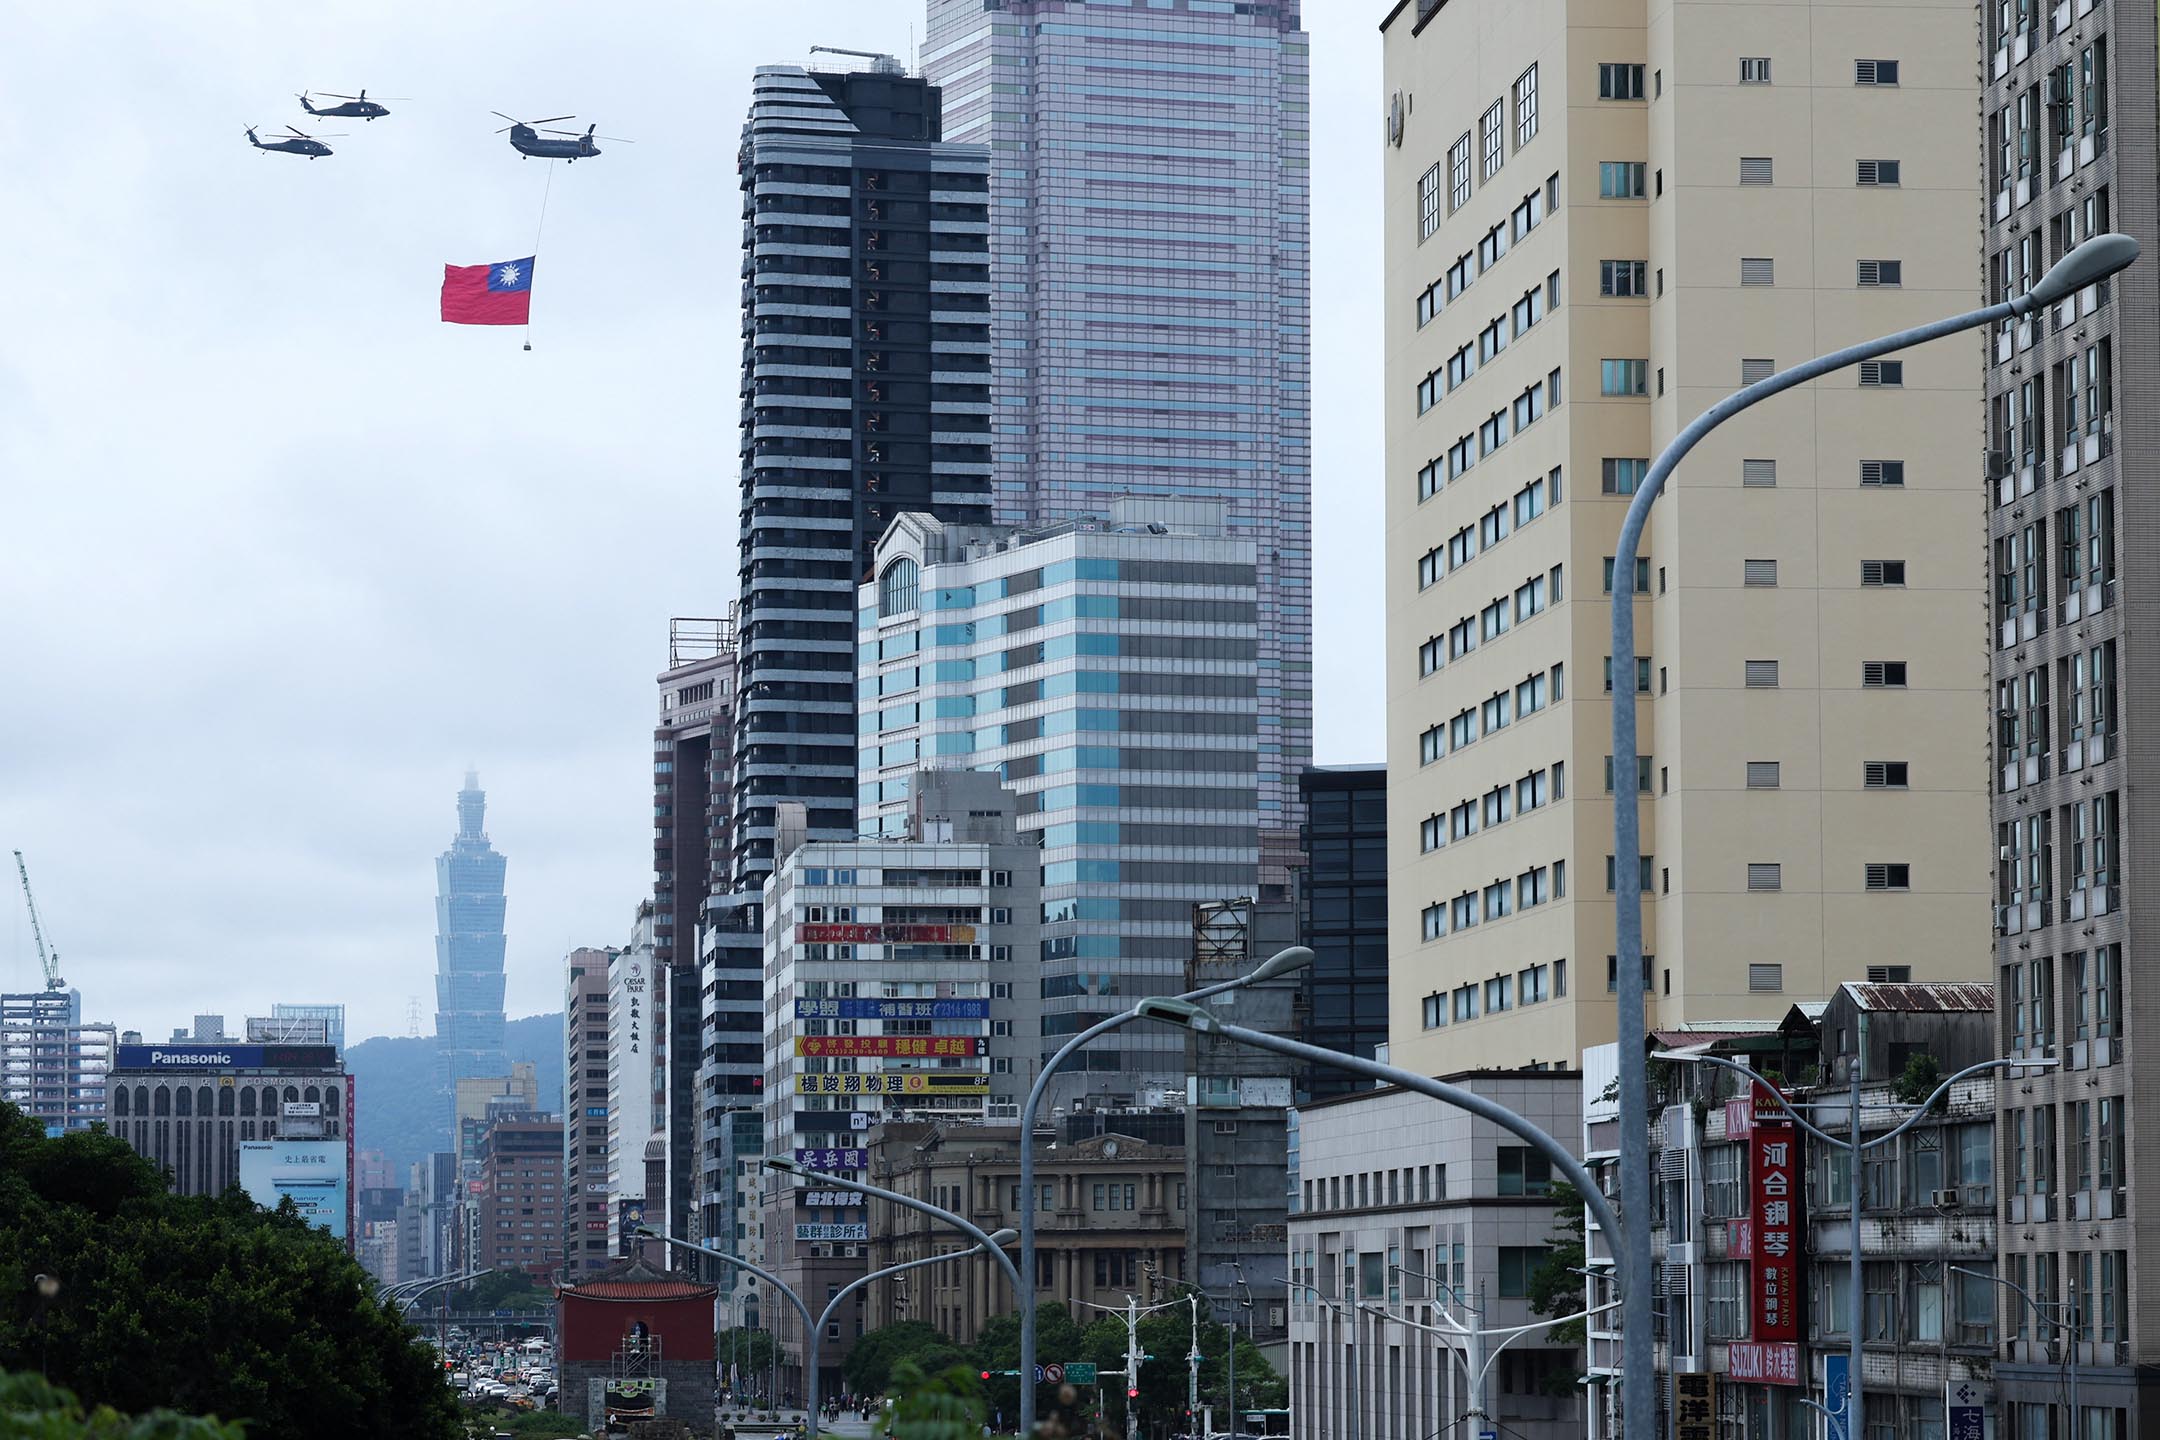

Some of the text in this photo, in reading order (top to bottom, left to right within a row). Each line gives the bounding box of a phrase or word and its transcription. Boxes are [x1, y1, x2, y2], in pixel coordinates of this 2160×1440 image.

[151, 1051, 231, 1065] Panasonic
[245, 1077, 294, 1087] COSMOS
[299, 1077, 336, 1087] HOTEL
[801, 1075, 904, 1093] 楊竣翔物理
[973, 1076, 987, 1086] 8F
[1729, 1103, 1750, 1133] KAW
[801, 1150, 867, 1168] 吳岳國
[1762, 1142, 1789, 1258] 河合鋼琴
[1782, 1267, 1790, 1327] KAWAI PIANO
[1731, 1344, 1763, 1378] SUZUKI
